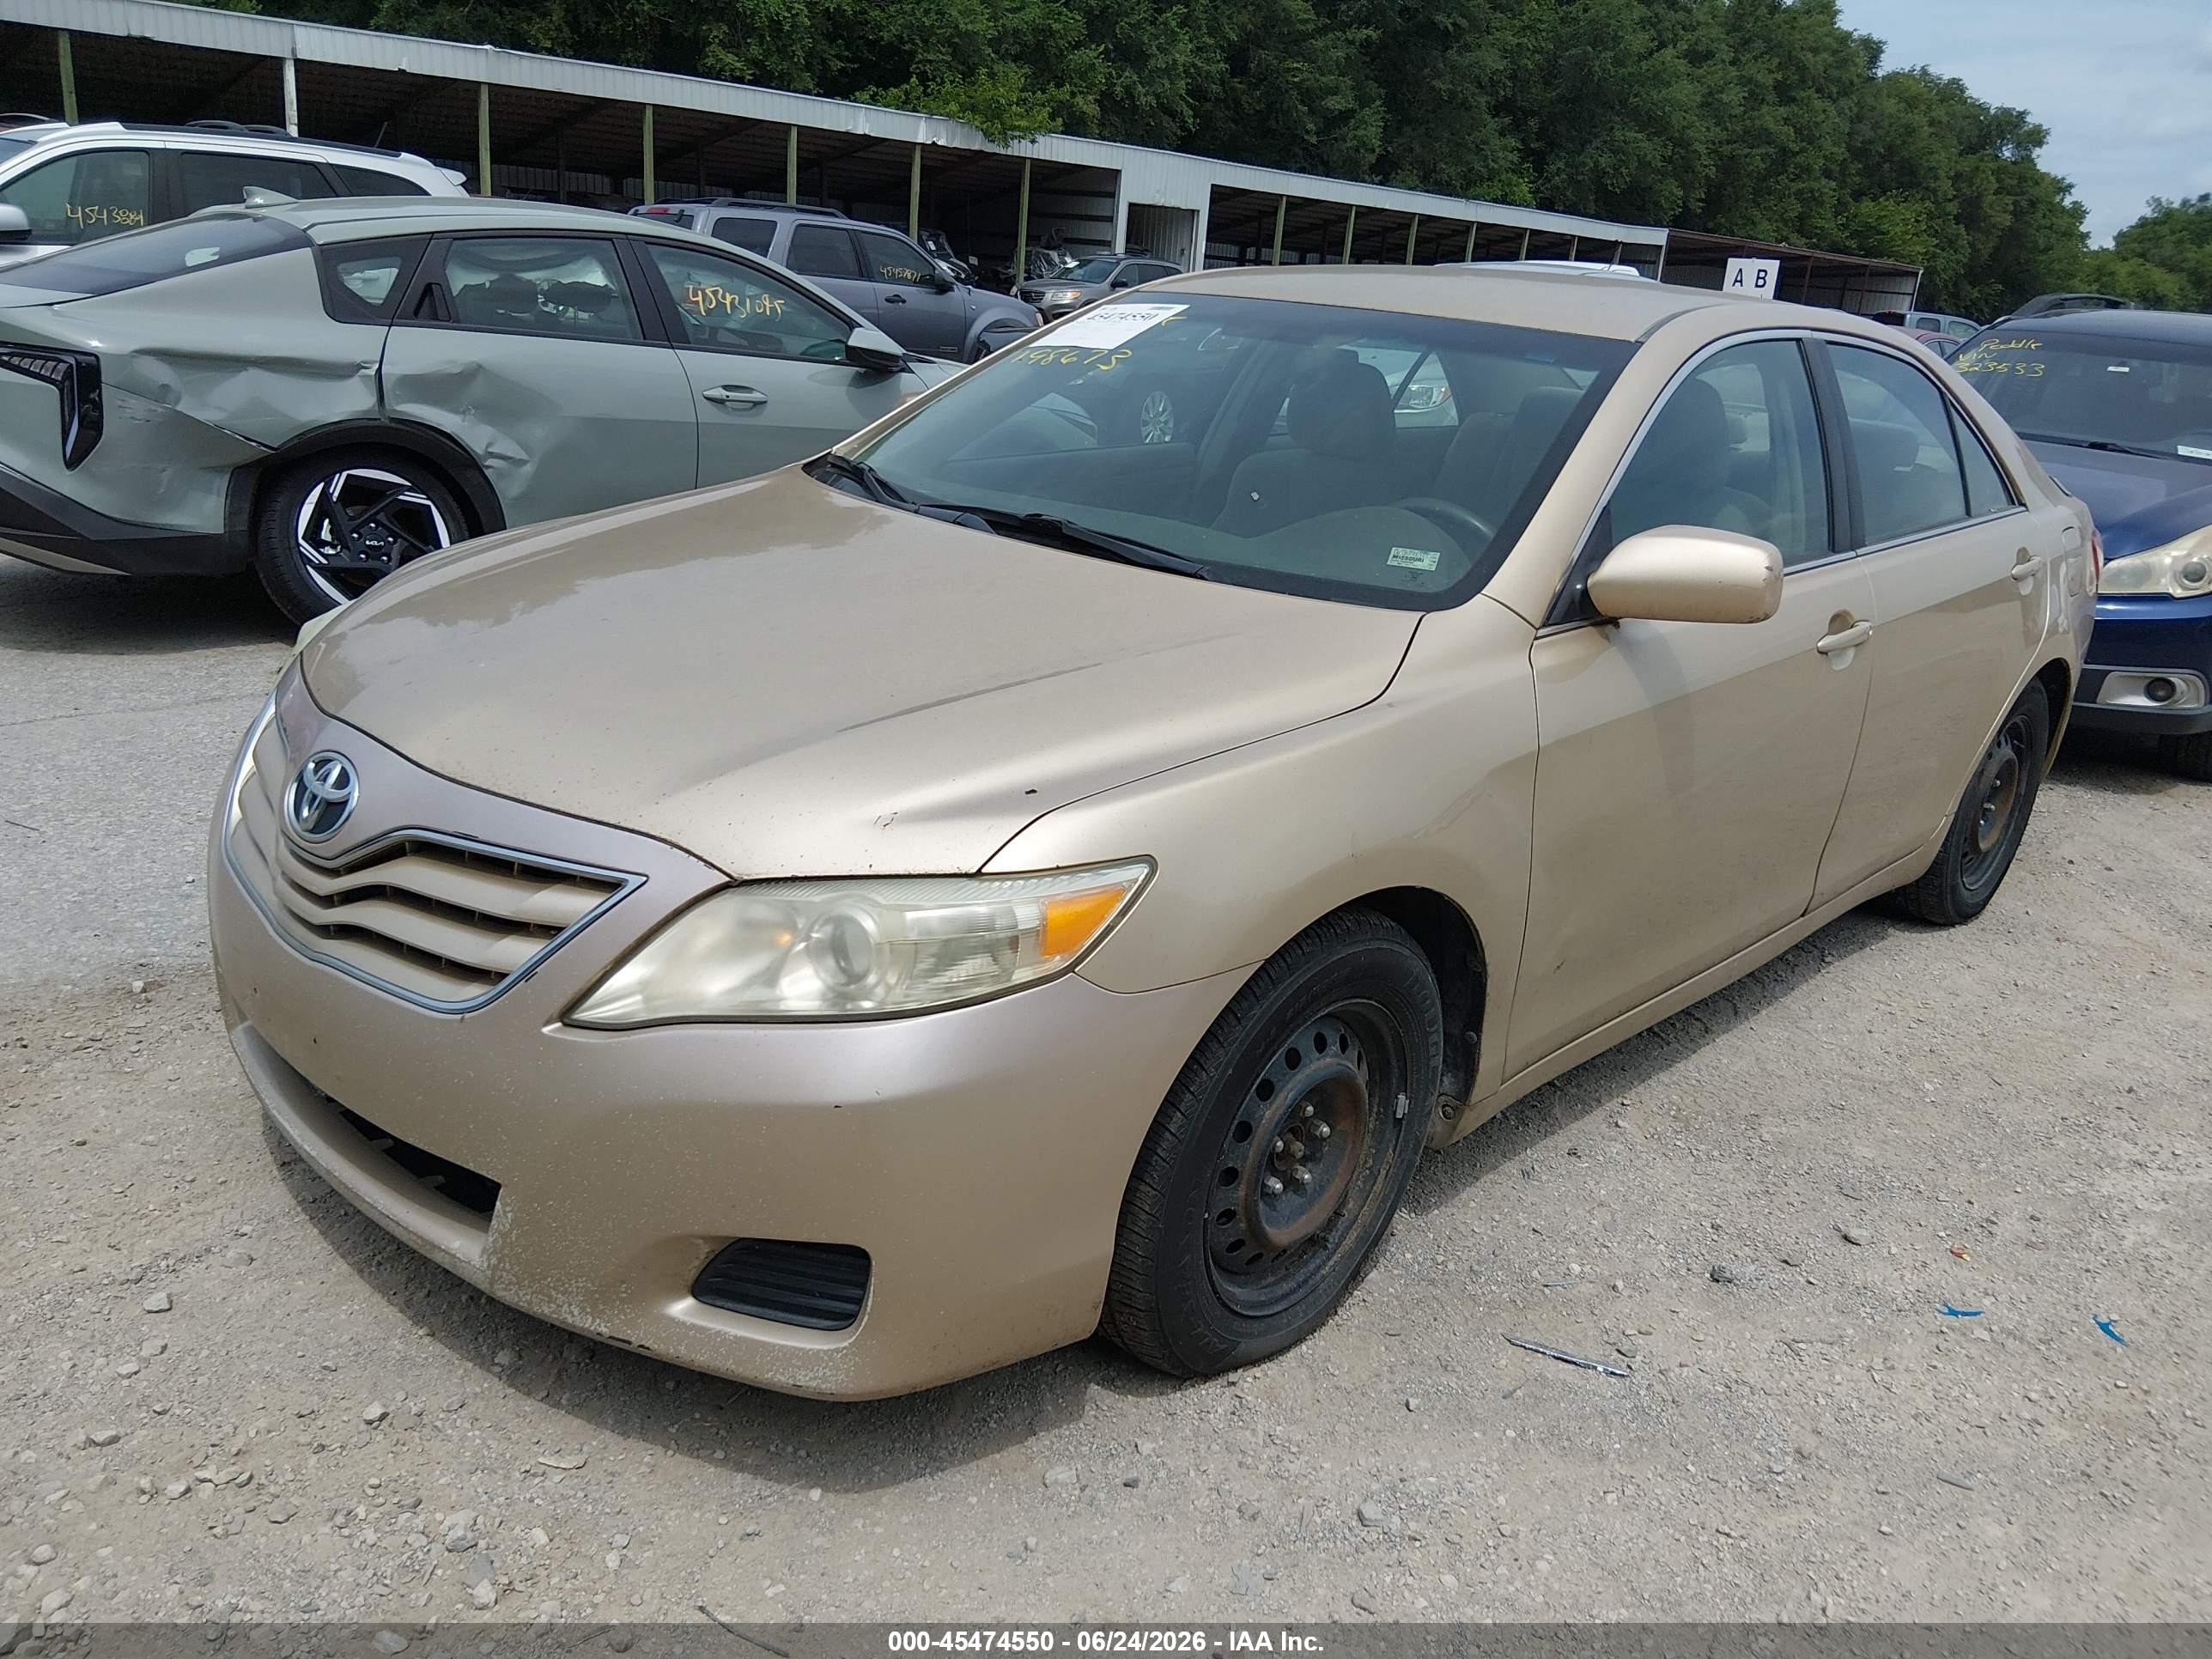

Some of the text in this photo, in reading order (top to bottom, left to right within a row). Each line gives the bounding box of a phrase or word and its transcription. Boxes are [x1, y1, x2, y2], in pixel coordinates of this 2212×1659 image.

[1731, 268, 1768, 288] A B
[1958, 352, 1997, 362] VIN
[1955, 362, 2045, 377] 323533
[1392, 555, 1425, 563] MISSOURI
